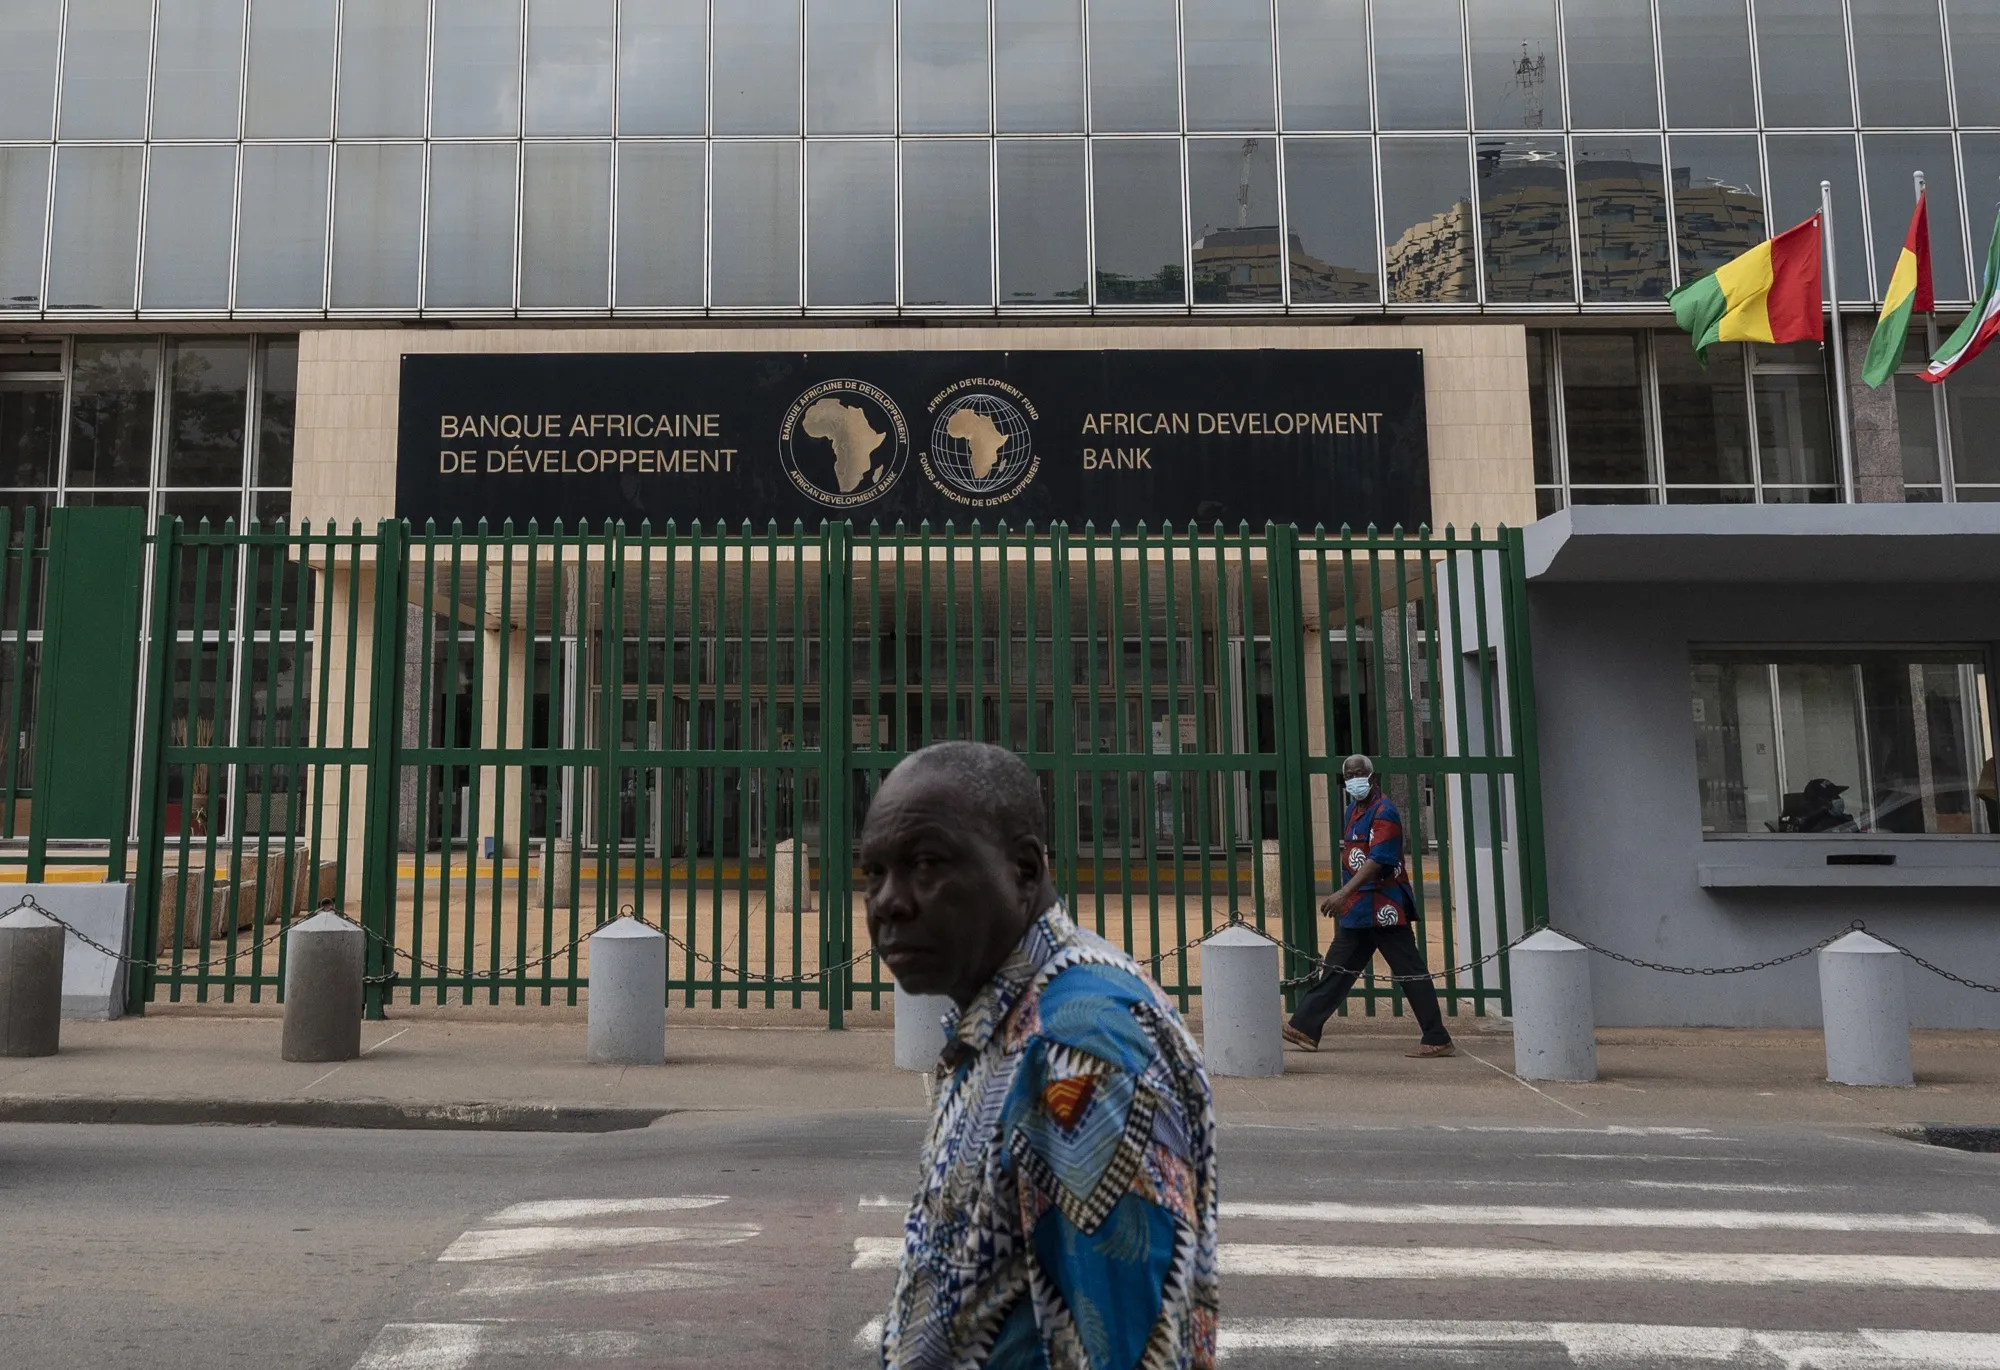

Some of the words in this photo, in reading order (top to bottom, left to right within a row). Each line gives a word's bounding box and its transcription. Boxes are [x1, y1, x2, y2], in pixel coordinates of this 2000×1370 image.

[782, 405, 802, 440] BANQUE
[800, 381, 843, 406] AFRICAINE
[845, 381, 857, 390] DE
[858, 383, 907, 445] DEVELOPPEMENT
[927, 383, 958, 414] AFRICAN
[959, 377, 1024, 399] DEVELOPMENT
[1021, 397, 1039, 421] FUND
[440, 414, 562, 440] BANQUE
[568, 414, 720, 437] AFRICAINE
[1082, 412, 1190, 434] AFRICAN
[1197, 412, 1383, 434] DEVELOPMENT
[439, 450, 477, 473] DE
[486, 444, 738, 473] DÉVELOPPEMENT
[1083, 447, 1152, 469] BANK
[790, 470, 821, 497] AFRICAN
[819, 490, 879, 505] DEVELOPMENT
[879, 470, 898, 492] BANK
[918, 452, 936, 481] FONDS
[933, 480, 970, 506] AFRICAIN
[971, 498, 984, 507] DE
[986, 455, 1041, 507] DEVELOPPEMENT
